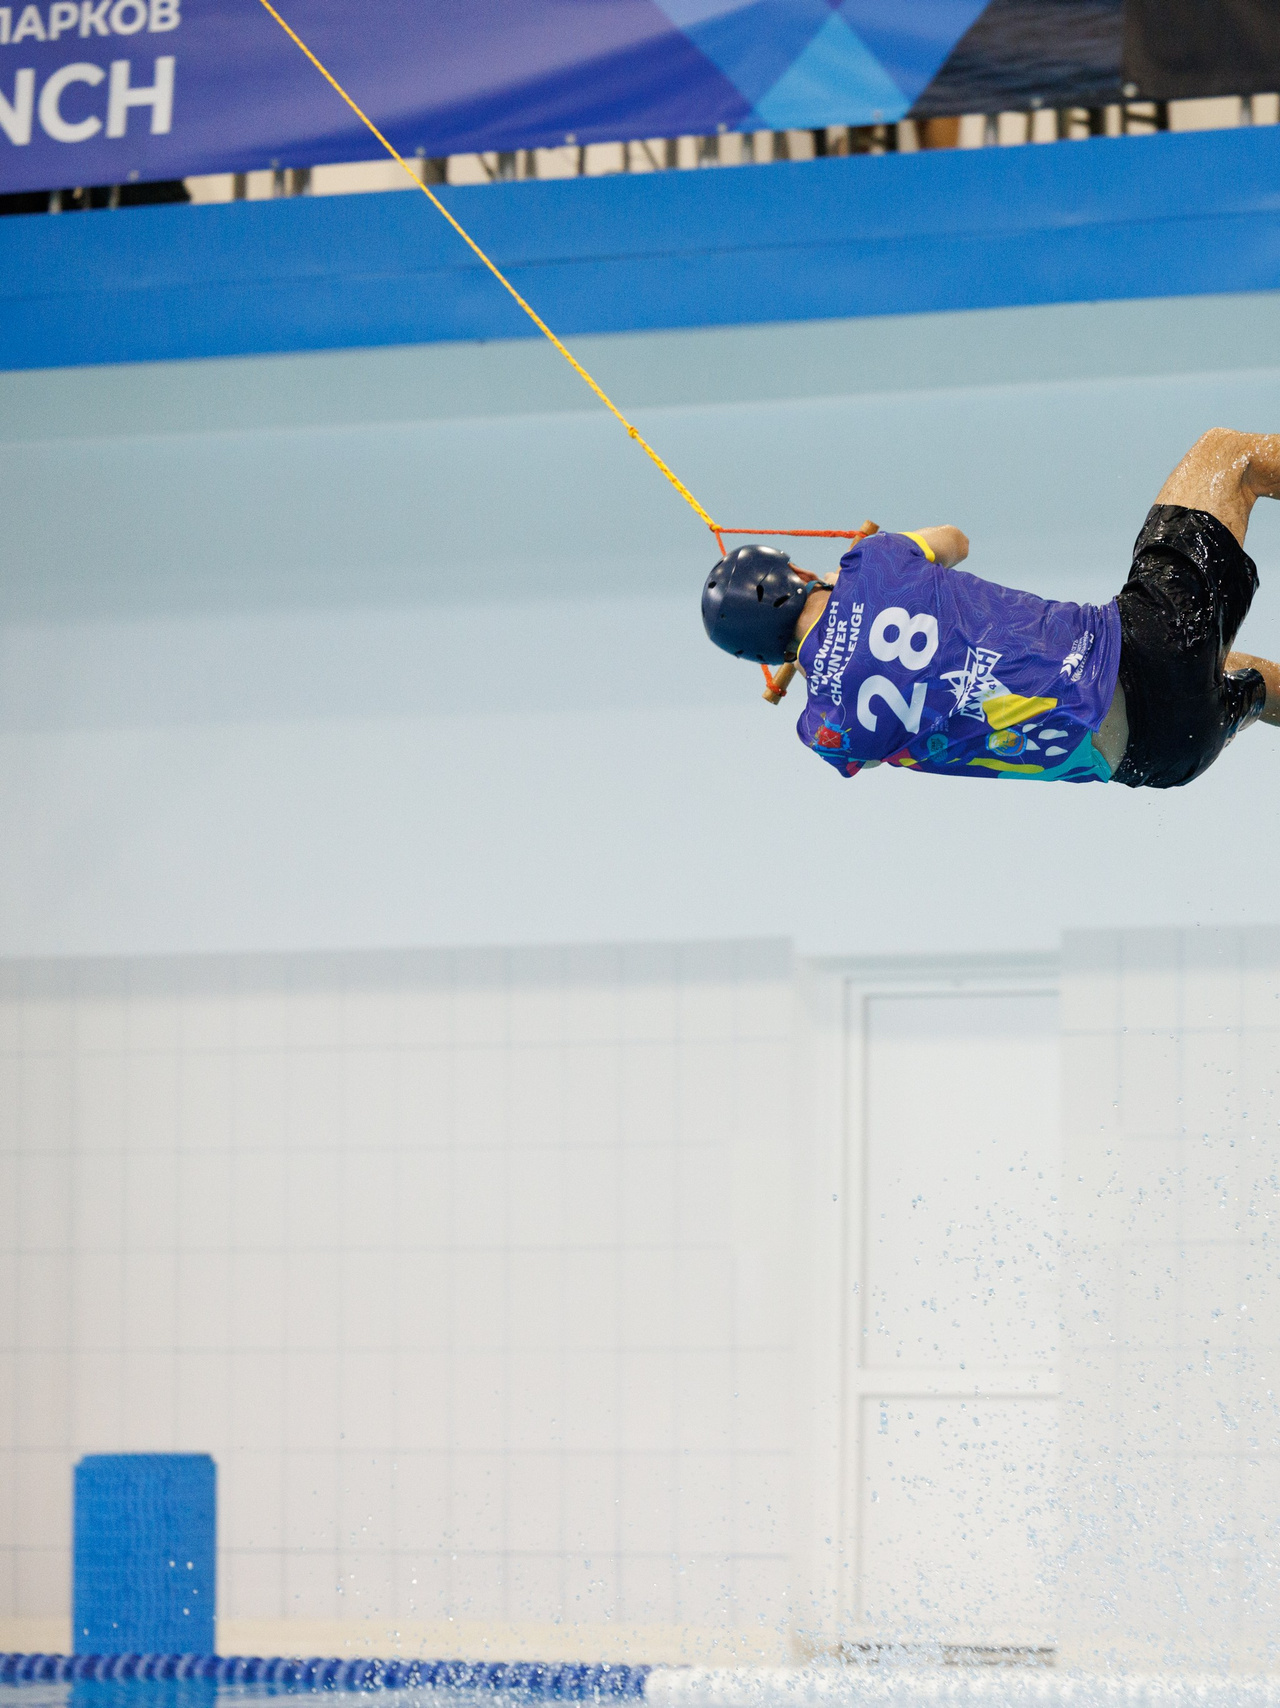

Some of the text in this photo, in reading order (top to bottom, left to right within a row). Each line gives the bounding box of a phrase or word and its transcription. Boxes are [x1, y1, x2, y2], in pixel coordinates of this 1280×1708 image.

[820, 620, 848, 686] WINTER
[832, 602, 865, 706] CHALLENGE
[856, 606, 939, 735] 28
